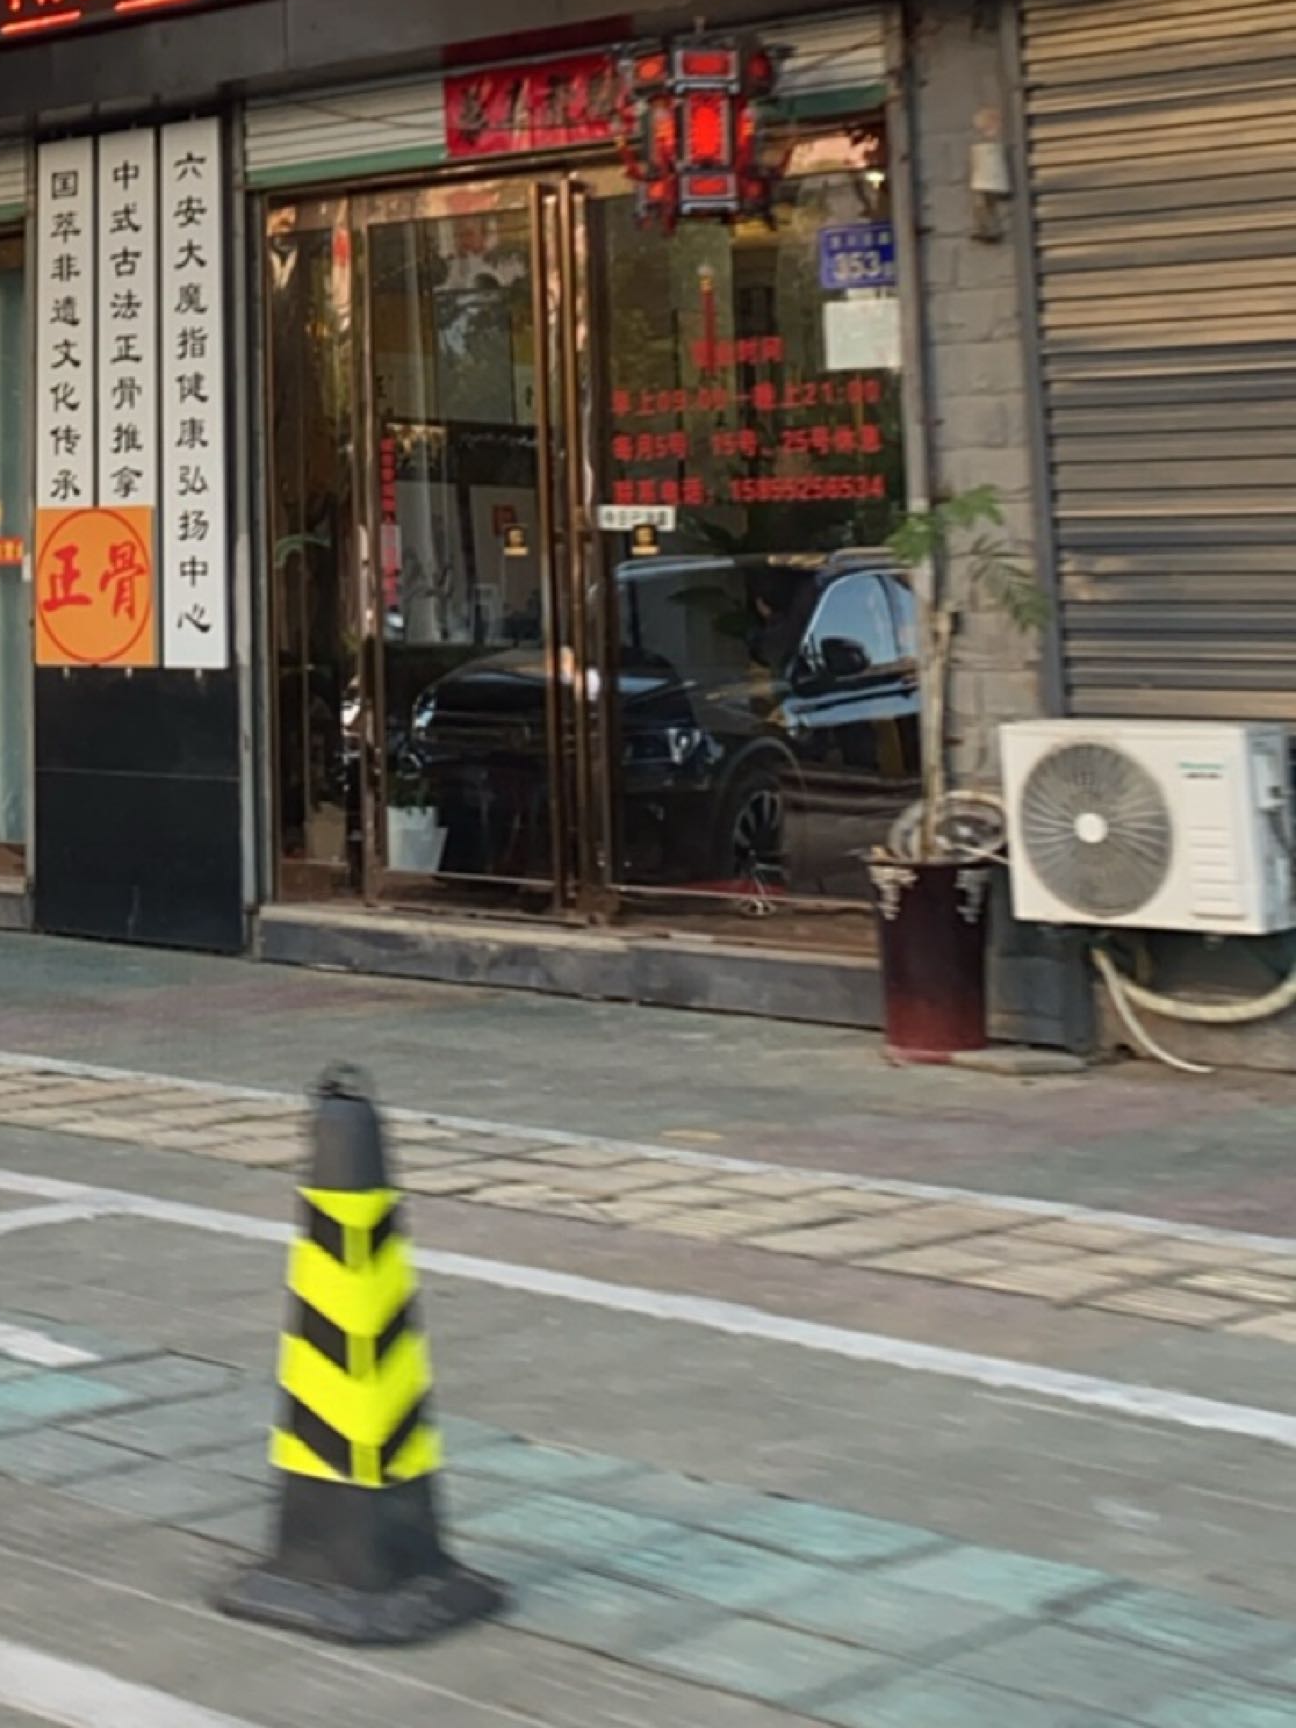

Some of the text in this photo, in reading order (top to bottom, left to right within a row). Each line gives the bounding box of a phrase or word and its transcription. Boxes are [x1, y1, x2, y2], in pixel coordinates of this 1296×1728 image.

[109, 159, 144, 499] 中式古法正骨推拿
[173, 150, 212, 634] 六安大魔指健康弘扬中心
[42, 540, 147, 621] 正骨
